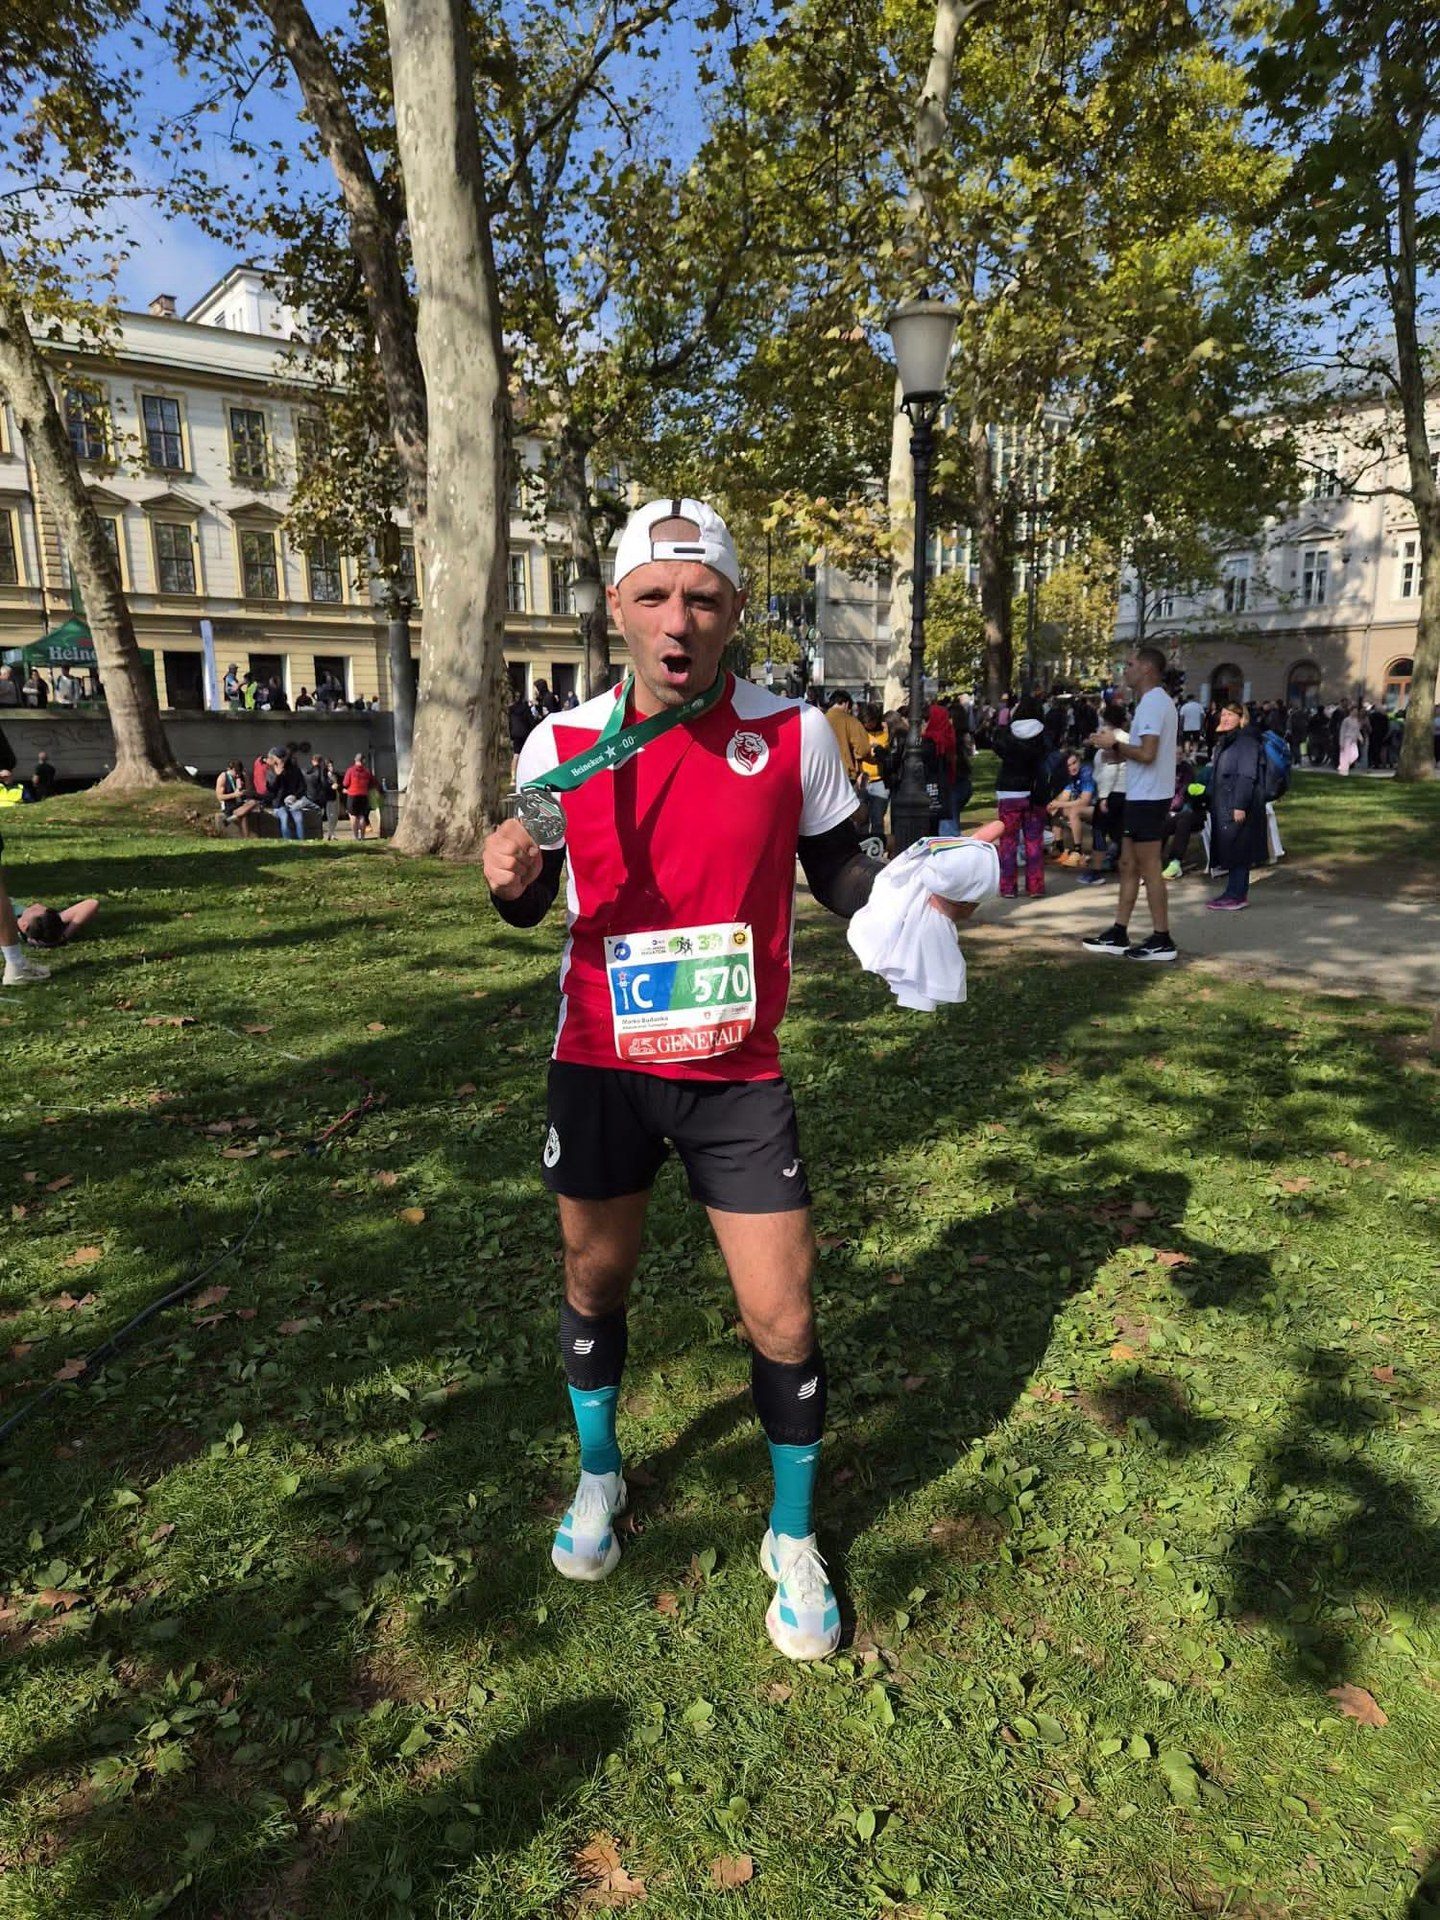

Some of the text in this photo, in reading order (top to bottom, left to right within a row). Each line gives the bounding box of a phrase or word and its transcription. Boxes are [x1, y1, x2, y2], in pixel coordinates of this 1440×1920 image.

[570, 754, 605, 777] Heineken
[694, 963, 749, 1003] 570
[656, 1026, 743, 1052] GENERALI
